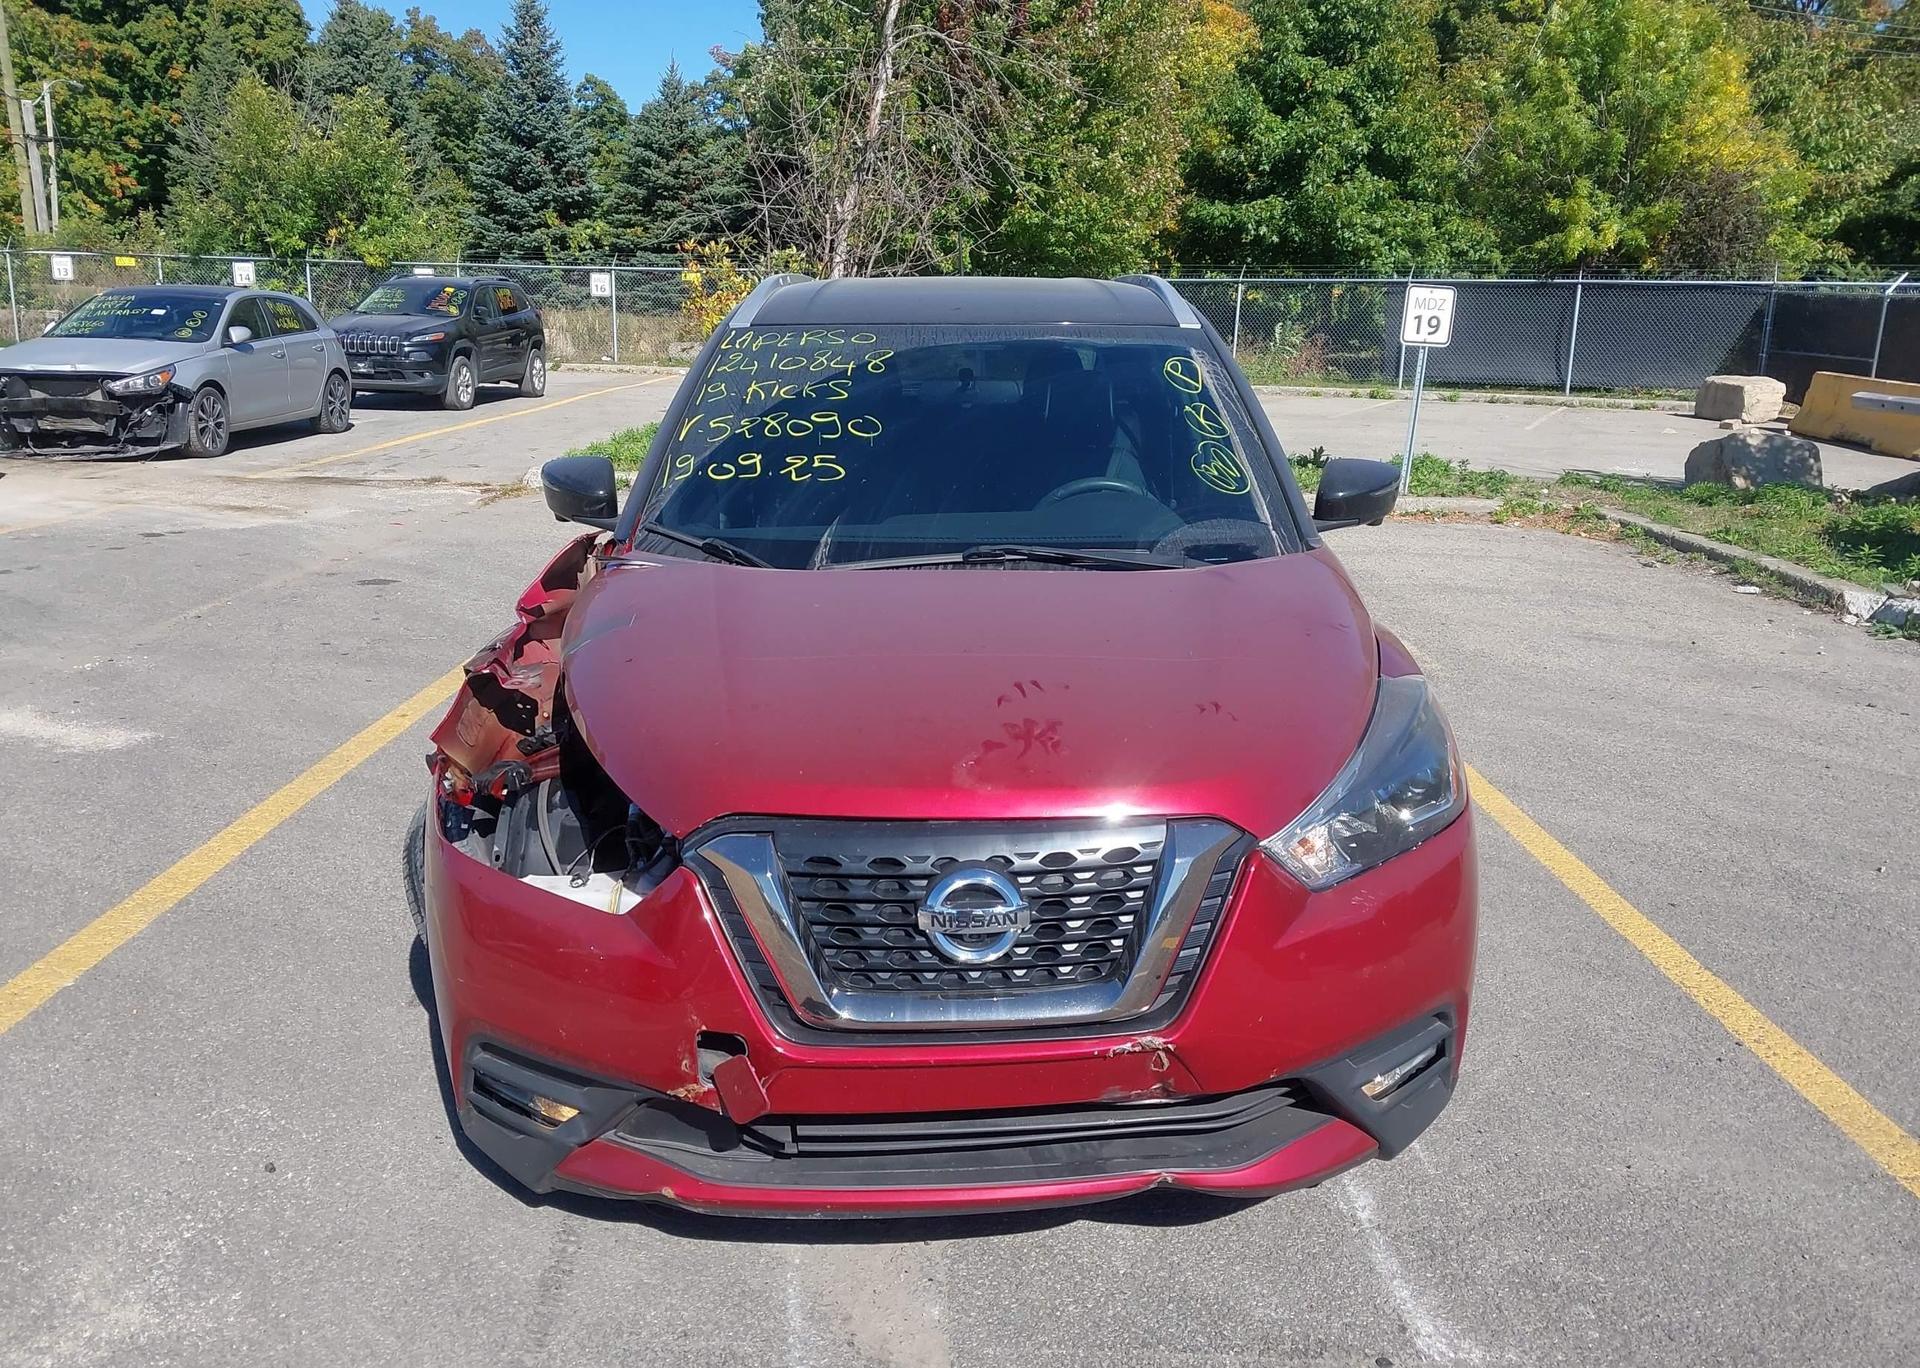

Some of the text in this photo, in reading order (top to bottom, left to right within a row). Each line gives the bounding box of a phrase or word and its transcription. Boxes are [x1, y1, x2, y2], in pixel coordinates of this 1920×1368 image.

[56, 267, 69, 277] 13
[239, 273, 251, 282] 14
[594, 284, 607, 293] 16
[1414, 297, 1447, 311] MDZ
[1413, 314, 1441, 336] 19
[930, 911, 1019, 929] NISSAN
